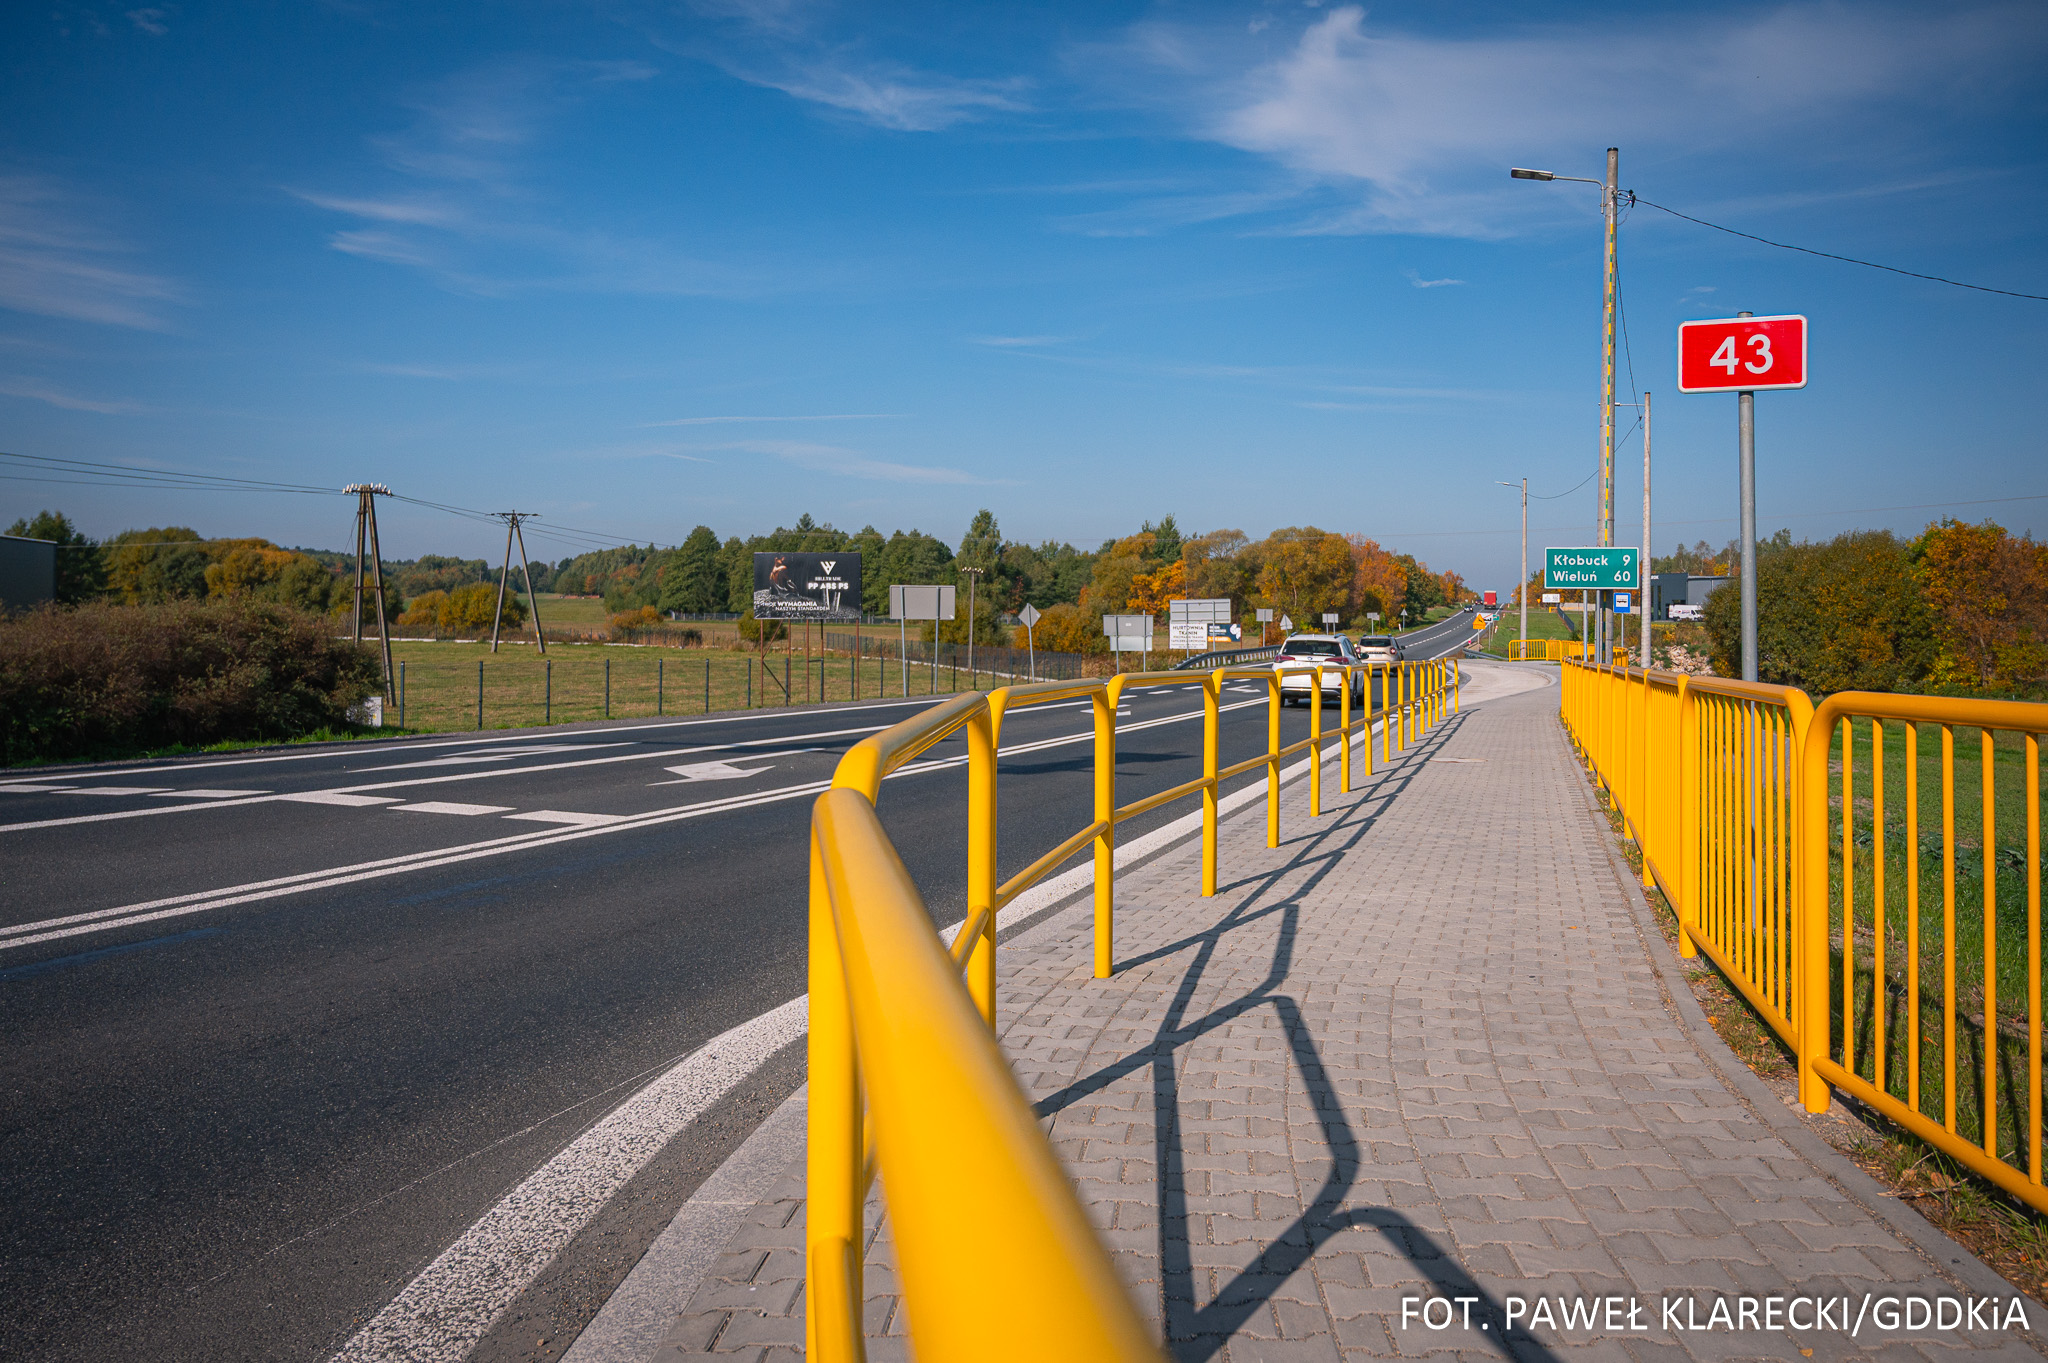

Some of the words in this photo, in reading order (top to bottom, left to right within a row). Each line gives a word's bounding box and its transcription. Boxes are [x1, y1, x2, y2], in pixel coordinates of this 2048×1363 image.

[1710, 333, 1774, 375] 43
[1554, 554, 1609, 566] Kłobuck
[1622, 554, 1631, 566] 9
[1553, 571, 1597, 582] Wieluń
[1613, 571, 1631, 582] 60
[808, 582, 819, 590] PP
[820, 582, 837, 590] ABS
[838, 582, 849, 590] PS
